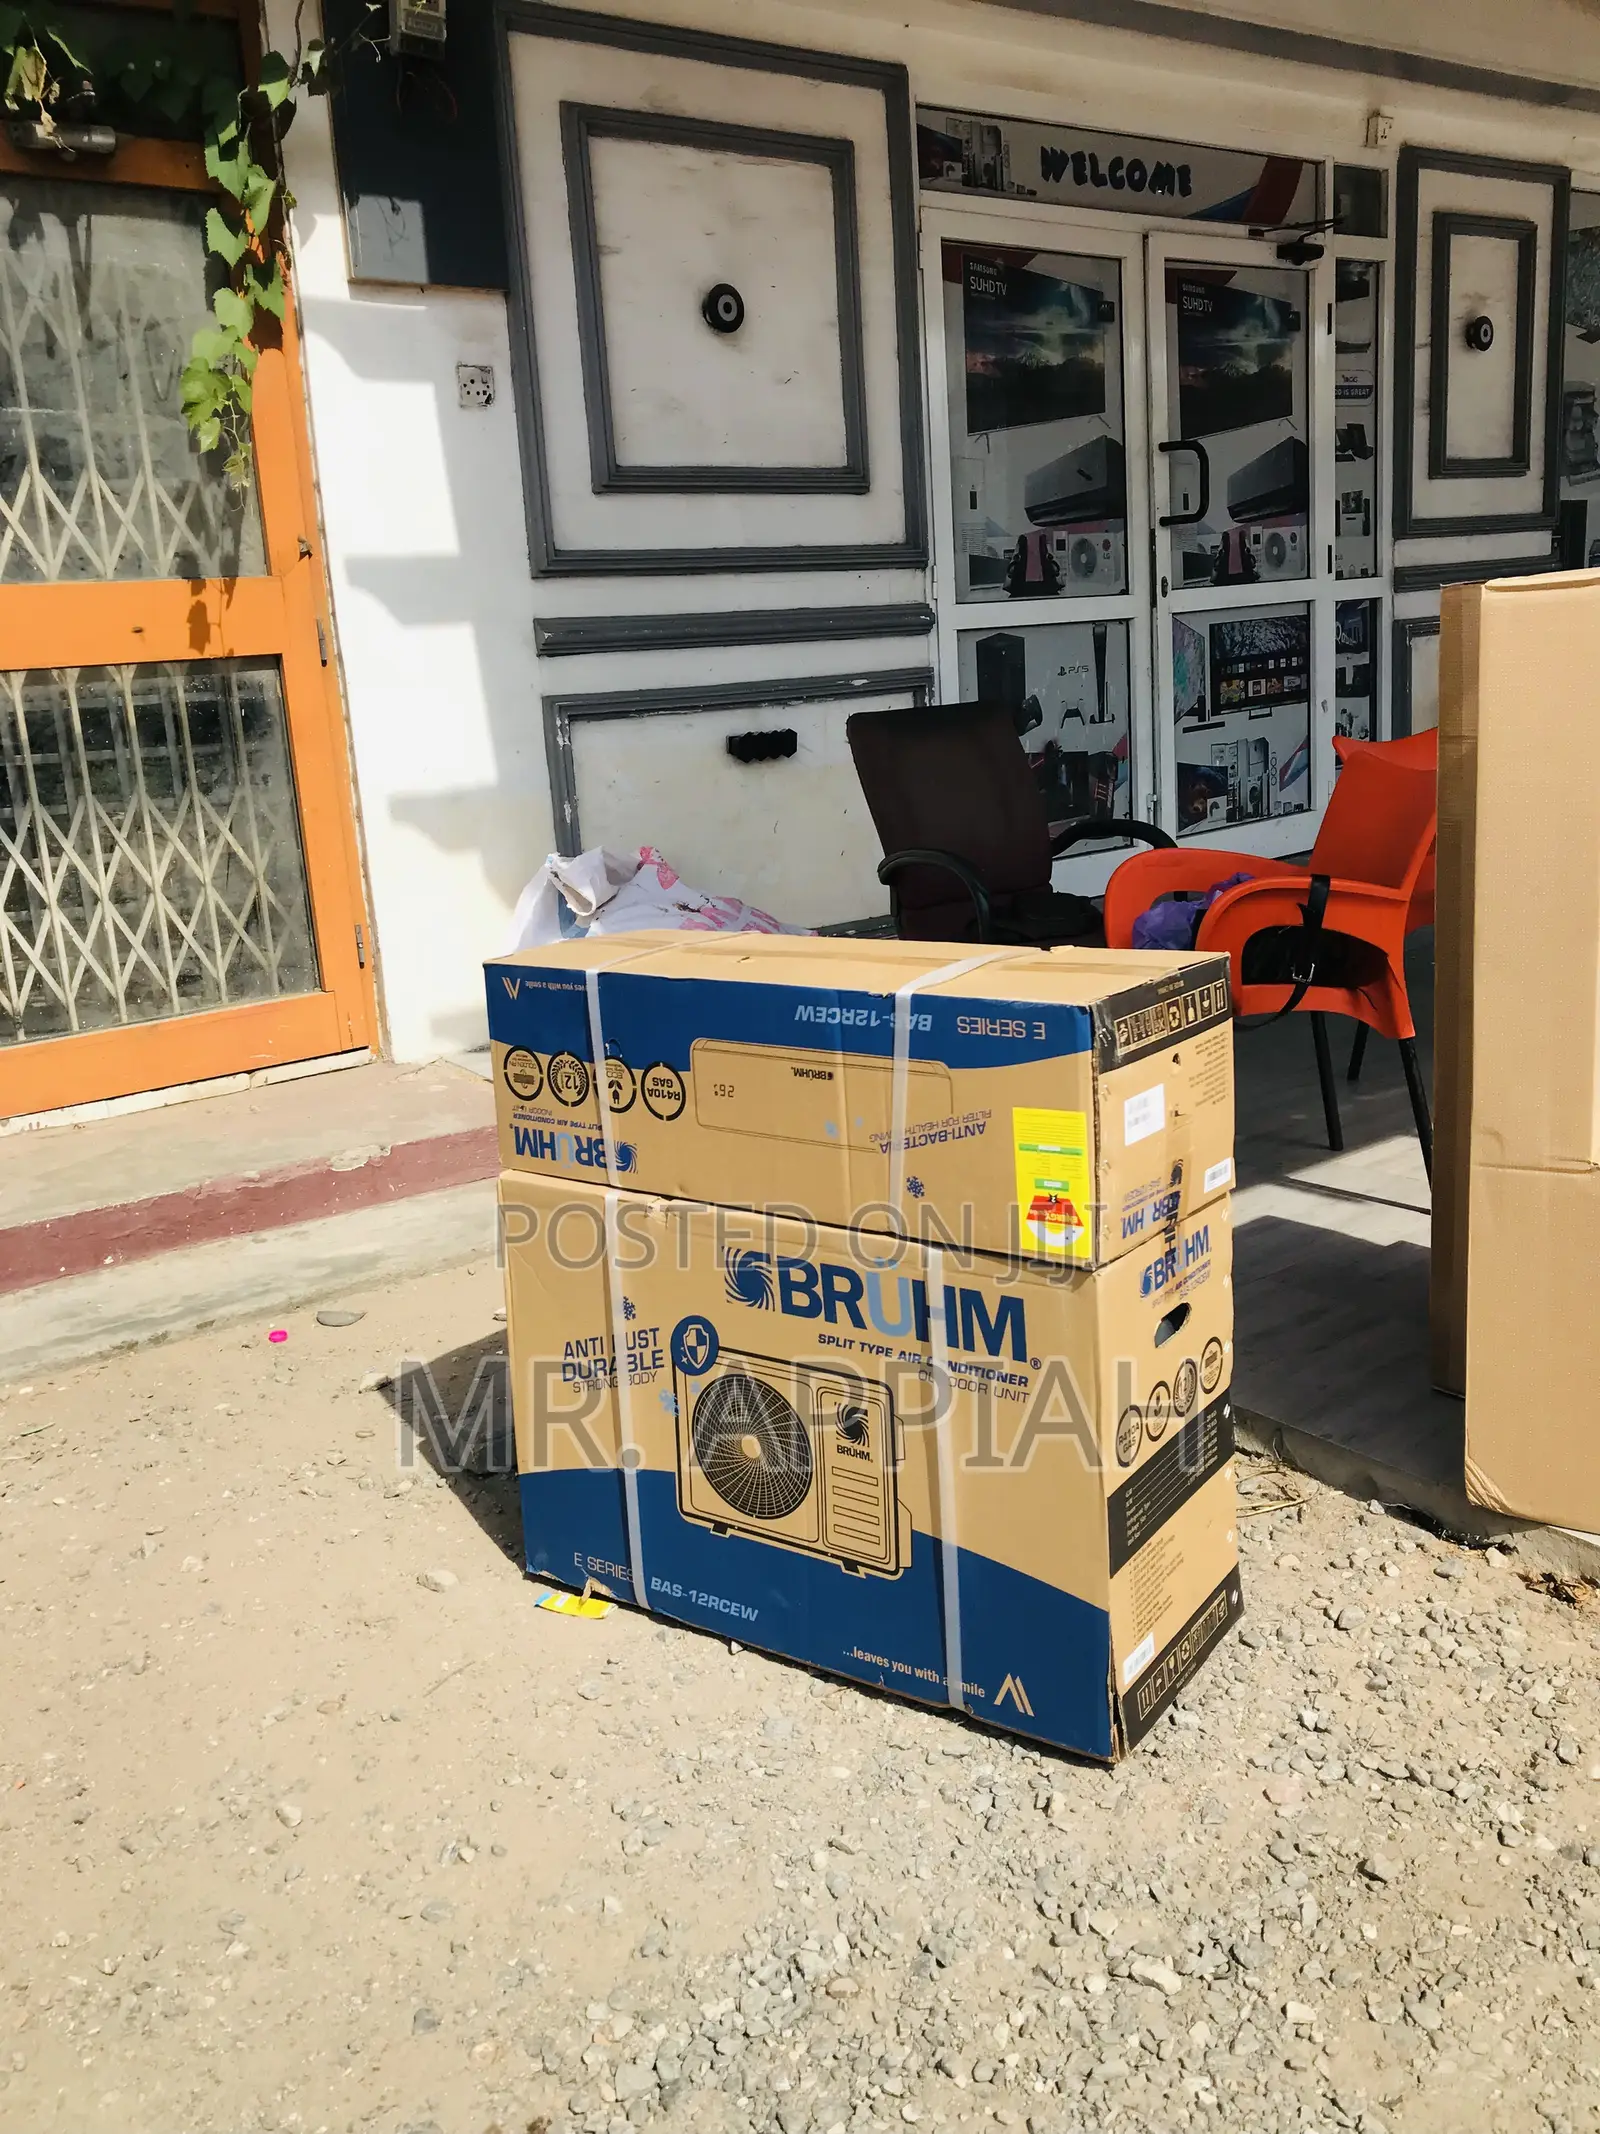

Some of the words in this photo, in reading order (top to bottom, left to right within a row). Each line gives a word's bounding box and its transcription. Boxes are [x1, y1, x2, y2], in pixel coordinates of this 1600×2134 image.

[1040, 145, 1193, 198] WELCOME
[969, 261, 998, 276] SAMSUNG
[1067, 664, 1090, 674] PS5
[525, 981, 541, 989] smile
[548, 982, 562, 991] with
[562, 982, 574, 991] you
[956, 1016, 1027, 1040] SERIES
[1033, 1021, 1047, 1041] E
[651, 1076, 674, 1089] GAS
[646, 1087, 681, 1102] R410A
[513, 1112, 555, 1125] CONDITIONER
[557, 1118, 568, 1128] AIR
[941, 1116, 961, 1129] FOR
[962, 1109, 992, 1124] FILTER
[570, 1120, 586, 1130] TYPE
[588, 1123, 603, 1132] PLIT
[904, 1121, 939, 1136] HEALTH
[869, 1129, 892, 1143] IVING
[879, 1121, 987, 1154] ANTI-BACTEIA
[777, 1254, 1028, 1363] BRÜHM
[563, 1335, 604, 1361] ANTI
[612, 1327, 660, 1353] UST
[818, 1333, 856, 1351] SPLIT
[859, 1341, 893, 1358] TYPE
[897, 1349, 921, 1366] AIR
[561, 1349, 665, 1382] DURABLE
[572, 1375, 618, 1394] STRONG
[918, 1369, 988, 1396] OUDOOR
[993, 1385, 1030, 1404] UNIT
[573, 1552, 583, 1568] E
[650, 1576, 760, 1623] BAS-12RCEW
[891, 1656, 913, 1676] you
[914, 1665, 941, 1684] with
[960, 1680, 986, 1698] mile
